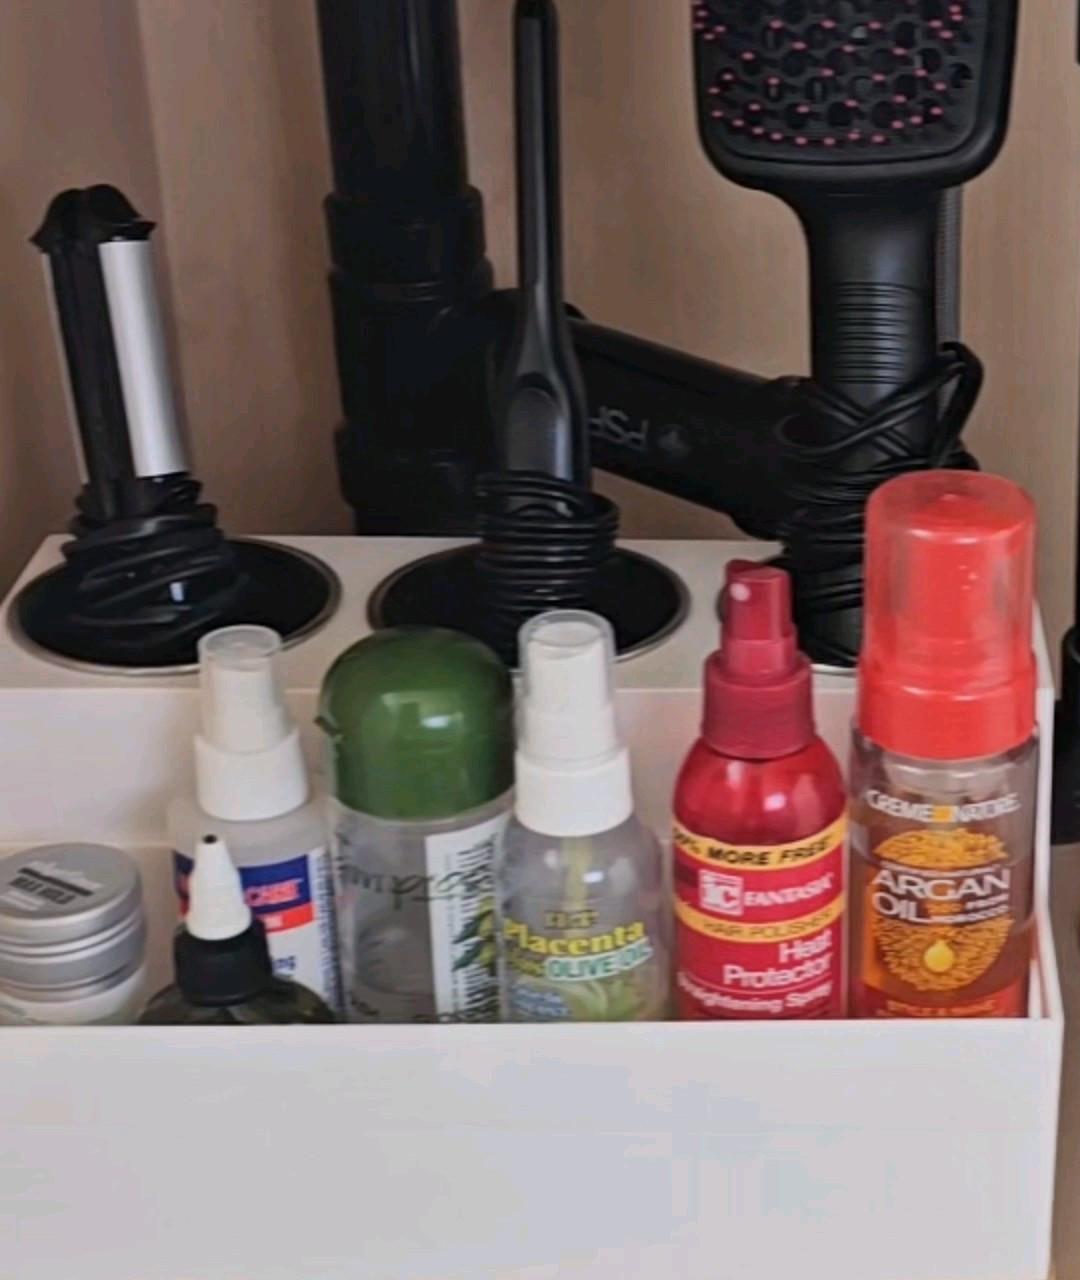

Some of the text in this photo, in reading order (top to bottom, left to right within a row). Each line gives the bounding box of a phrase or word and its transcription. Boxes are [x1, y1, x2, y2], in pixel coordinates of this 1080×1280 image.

[707, 833, 834, 865] MORE FREE
[871, 868, 1011, 901] ARGAN
[871, 891, 932, 923] OIL
[779, 928, 832, 964] Heat
[722, 952, 832, 989] Protector
